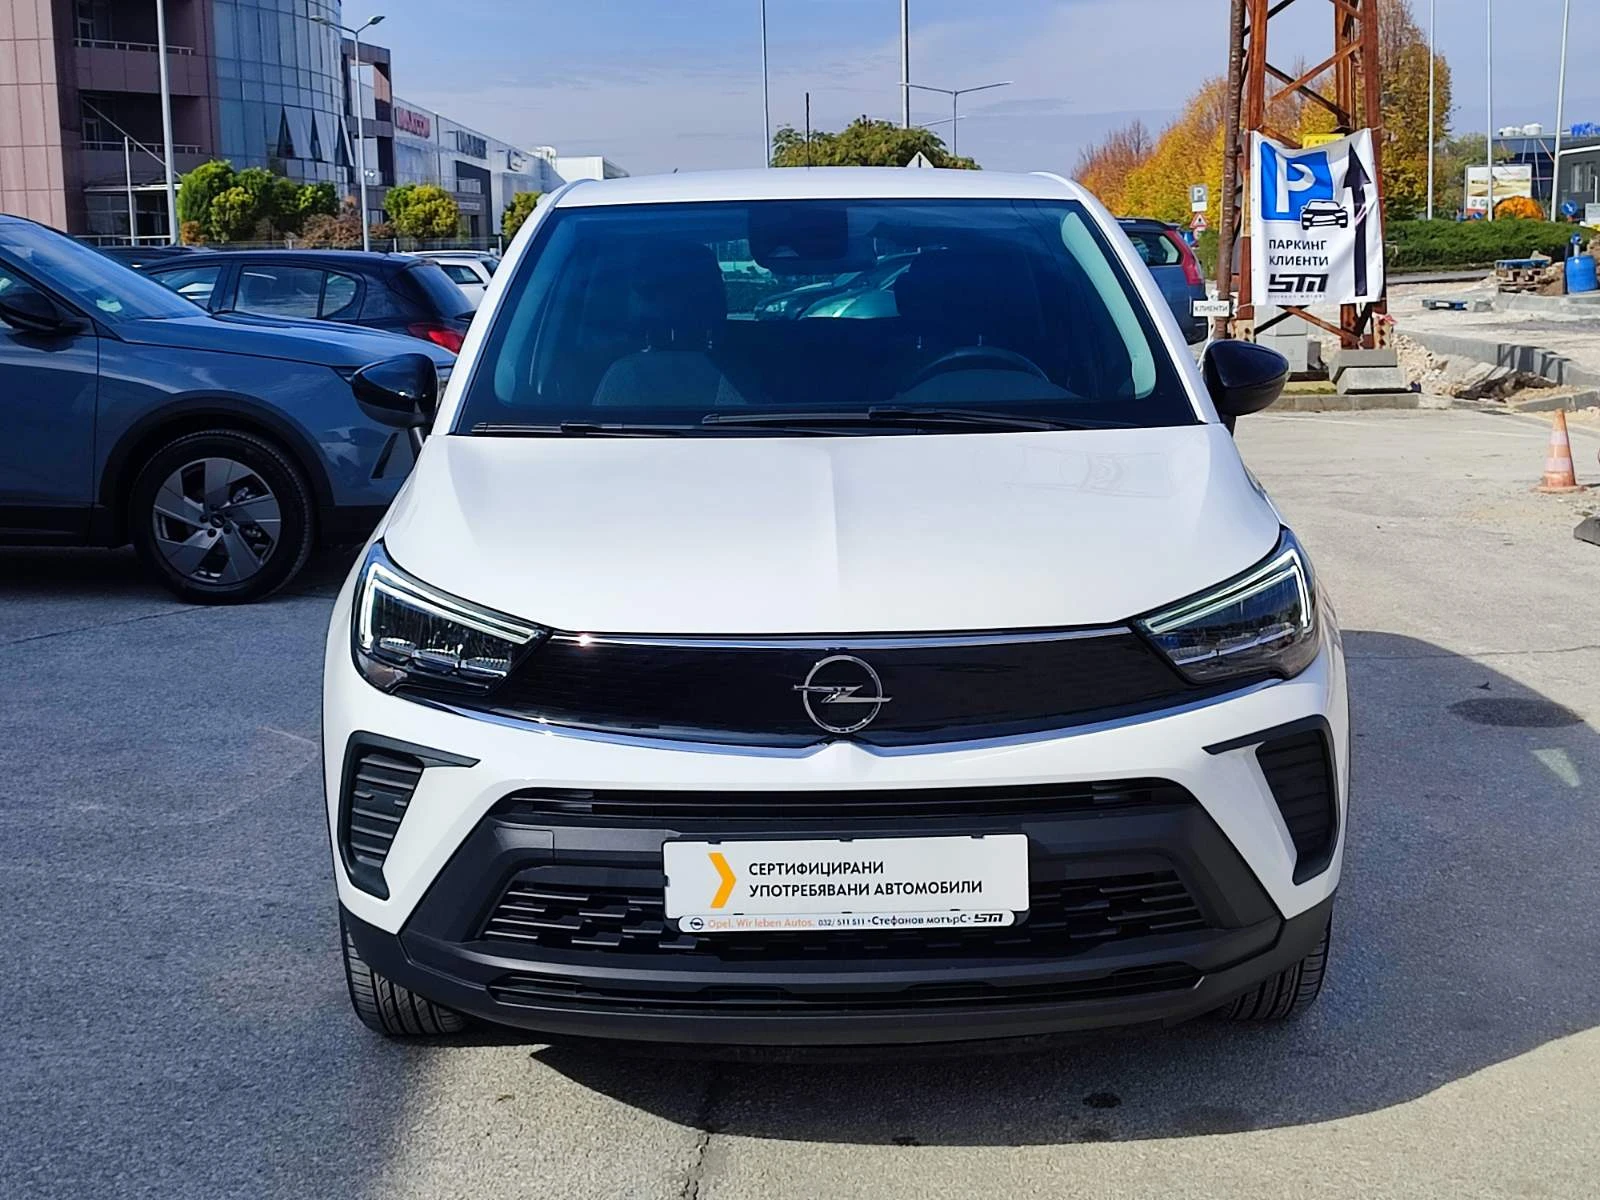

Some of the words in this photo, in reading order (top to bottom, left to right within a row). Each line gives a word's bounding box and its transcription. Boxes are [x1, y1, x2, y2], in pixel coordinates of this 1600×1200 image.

[1193, 187, 1204, 201] P
[1269, 239, 1327, 250] ПАРКИНГ
[1269, 255, 1329, 266] КЛИЕНТИ
[749, 861, 884, 877] СЕРТИФИЦИРАНИ
[749, 883, 870, 898] УПОТРЕБЯВАНИ
[874, 880, 983, 895] АВТОМОБИЛИ
[736, 918, 752, 928] Wir
[755, 918, 782, 928] leben
